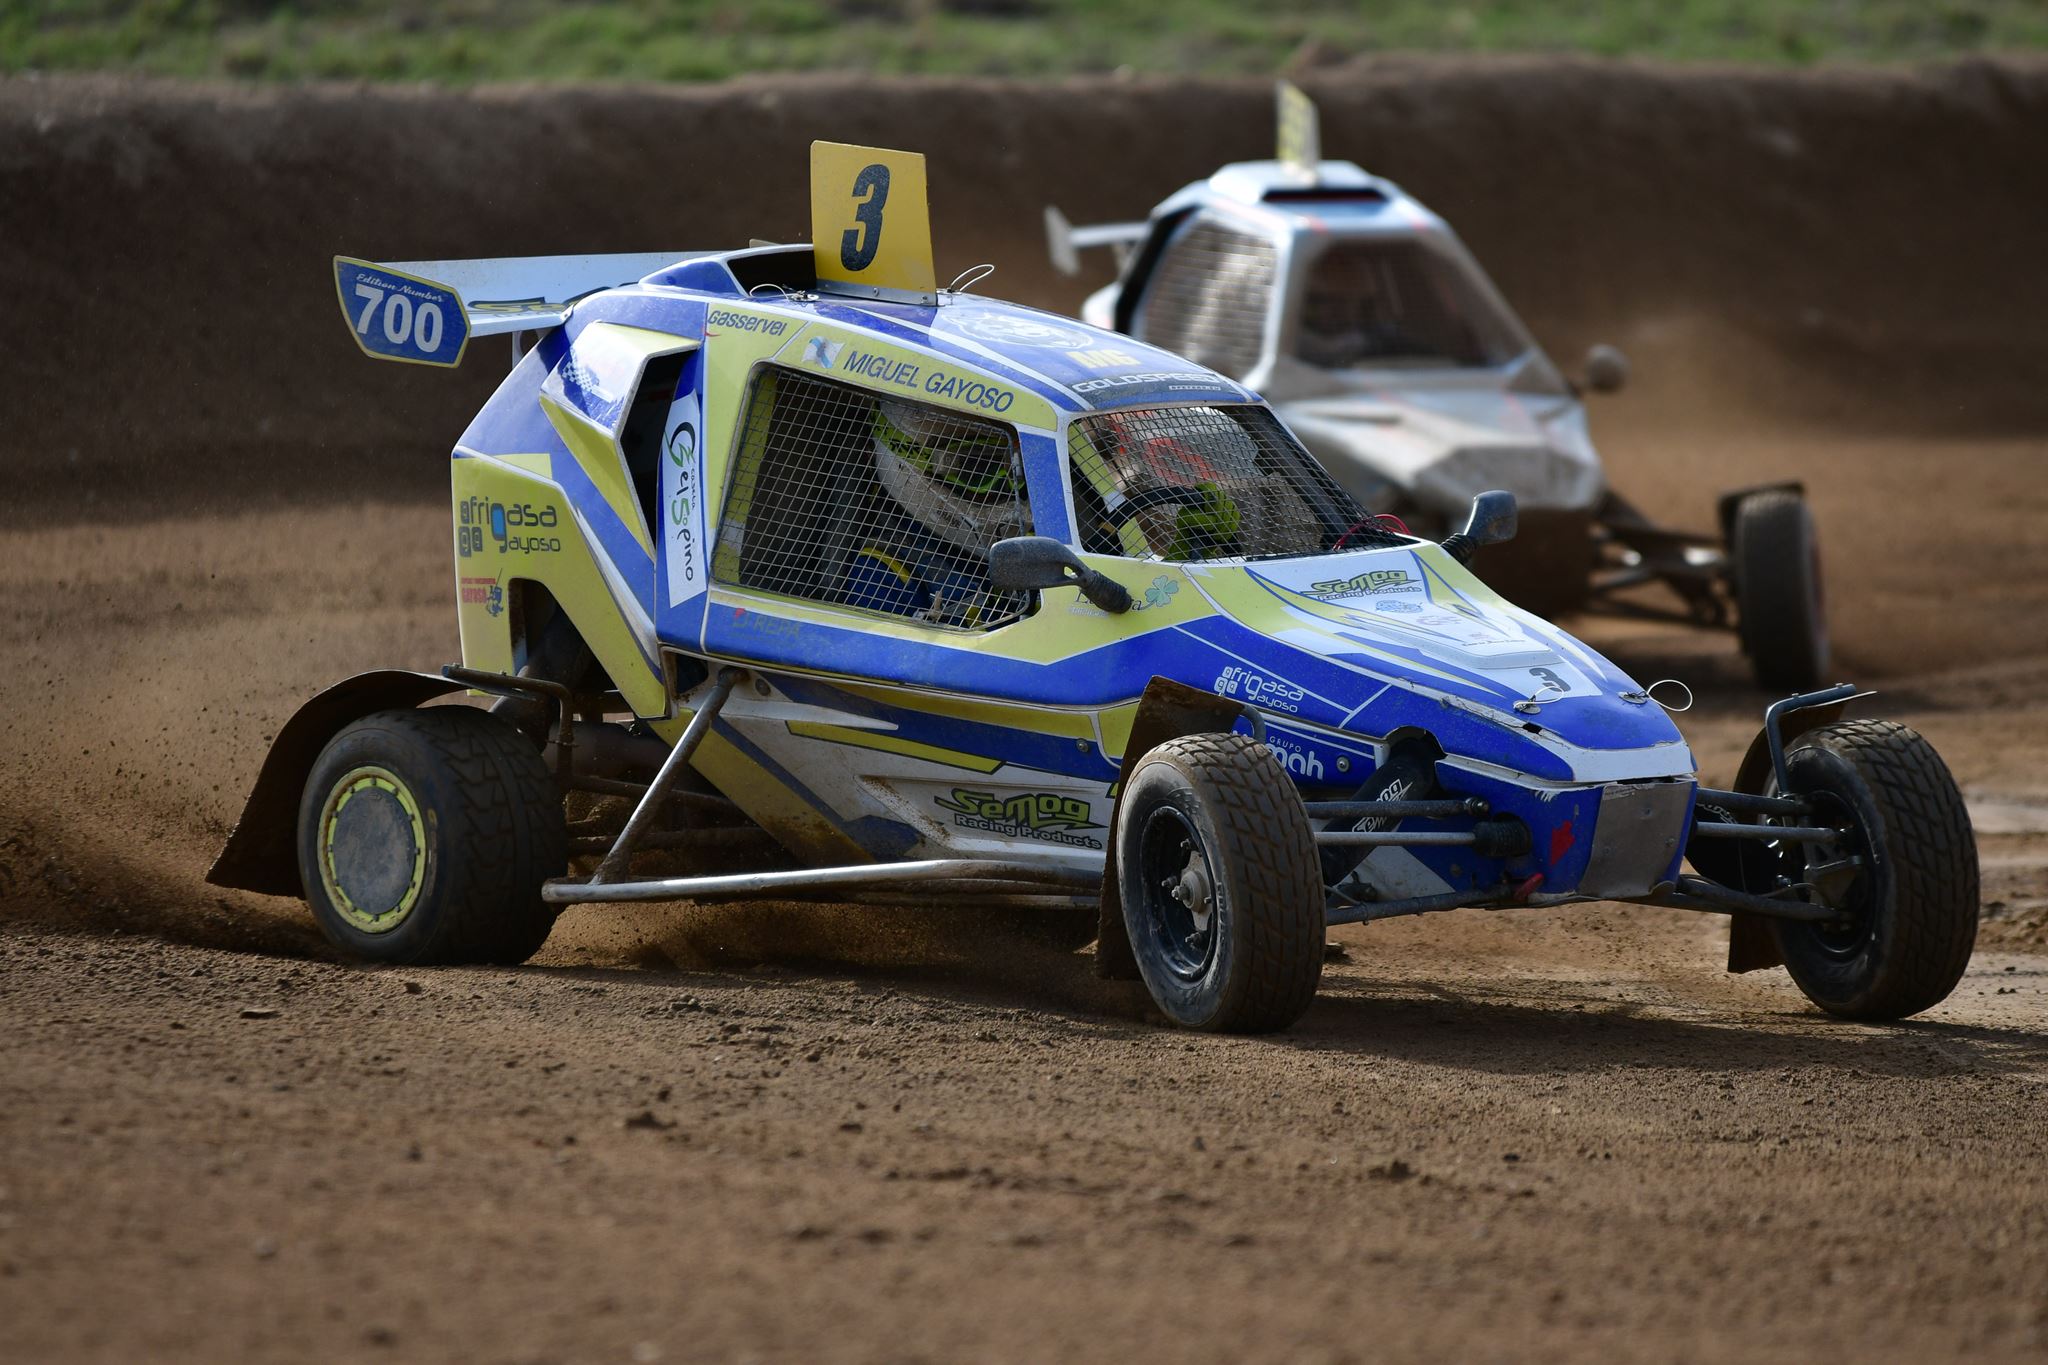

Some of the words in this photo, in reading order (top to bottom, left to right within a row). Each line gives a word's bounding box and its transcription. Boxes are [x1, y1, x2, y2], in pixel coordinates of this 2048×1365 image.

[840, 164, 890, 271] 3
[356, 273, 397, 291] Edition
[397, 284, 445, 302] Number
[355, 283, 443, 353] 700
[844, 351, 919, 388] MIGUEL
[925, 372, 1014, 413] GAYOSO
[1529, 667, 1571, 692] 3
[1270, 736, 1302, 753] GRUPO
[954, 814, 1017, 837] Racing
[1019, 826, 1103, 850] Products
